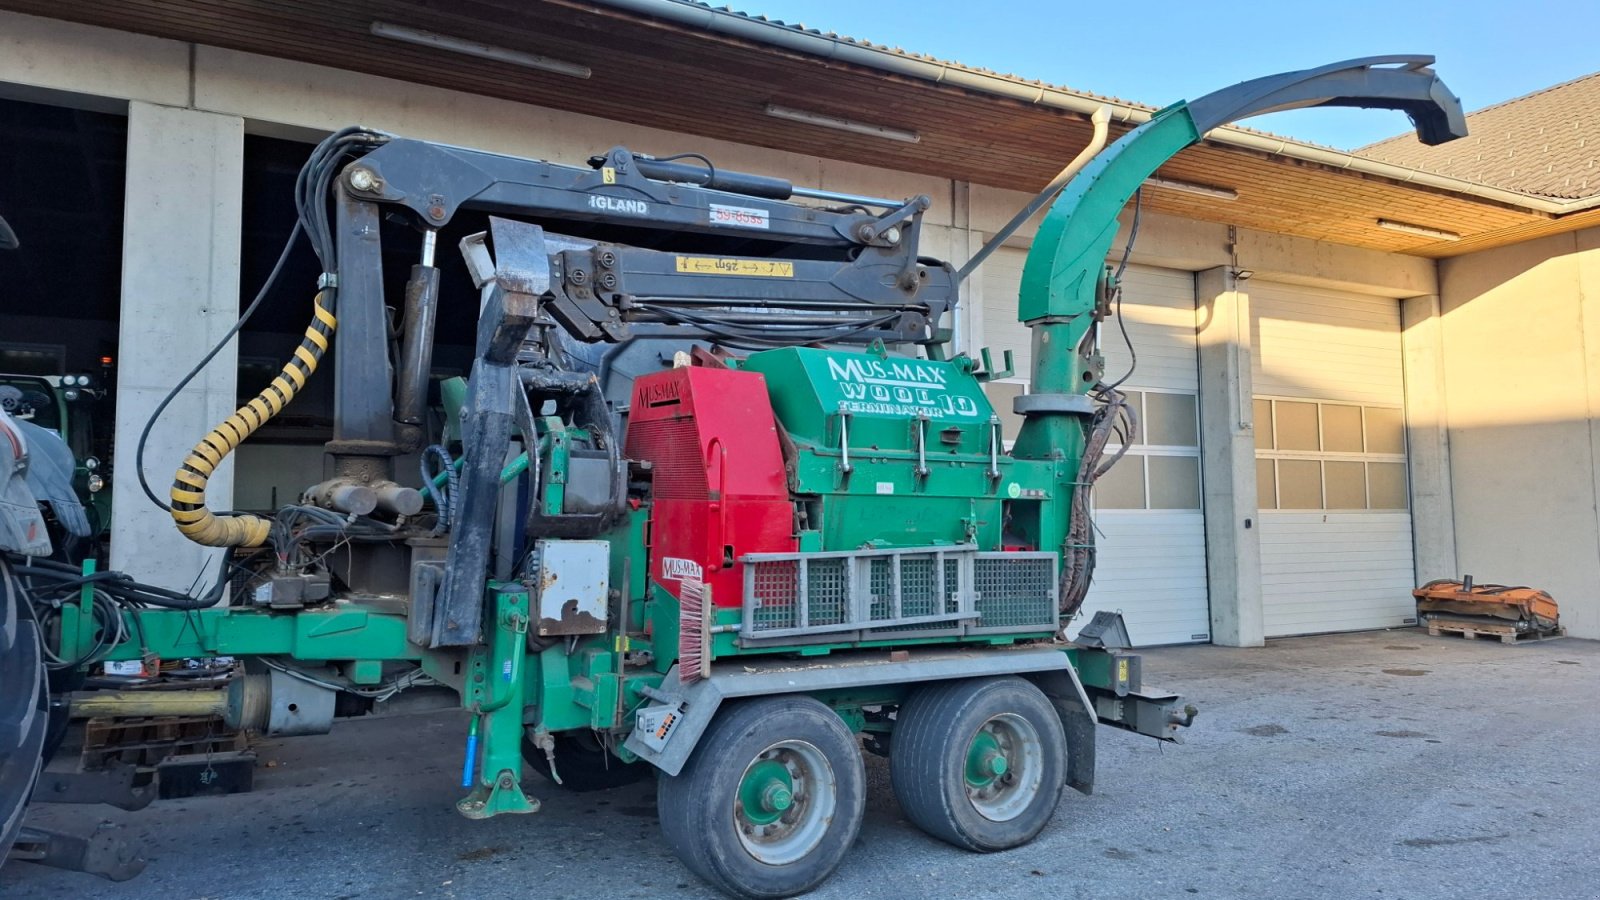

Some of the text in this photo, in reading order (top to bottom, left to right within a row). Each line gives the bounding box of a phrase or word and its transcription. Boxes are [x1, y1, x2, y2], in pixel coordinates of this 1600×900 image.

[589, 195, 648, 214] IGLAND
[826, 356, 947, 384] MUS-MAX
[638, 380, 680, 408] MUS-MAX
[936, 394, 978, 417] 10
[663, 558, 702, 578] MUS-MAX
